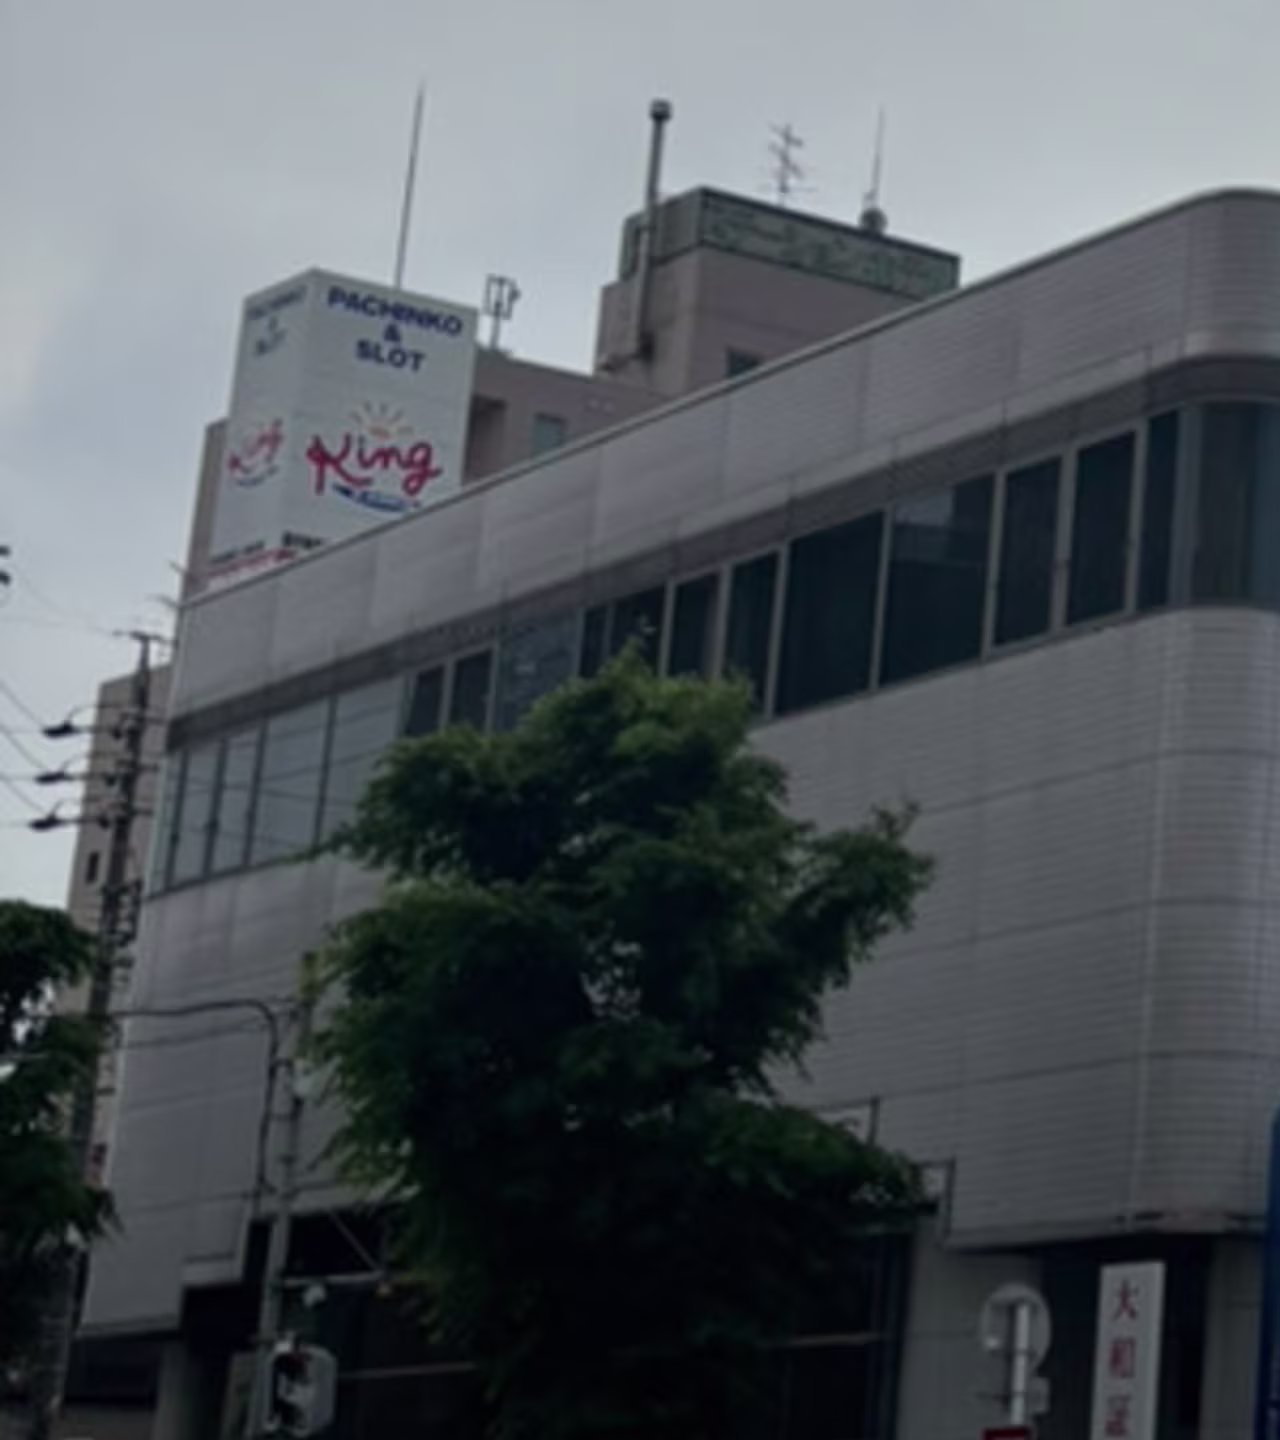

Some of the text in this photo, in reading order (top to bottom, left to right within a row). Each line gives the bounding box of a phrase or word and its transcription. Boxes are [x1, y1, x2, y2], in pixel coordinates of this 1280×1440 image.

[327, 286, 463, 336] PACHINKO
[383, 323, 401, 344] &
[356, 340, 425, 372] SLOT
[306, 432, 443, 497] King
